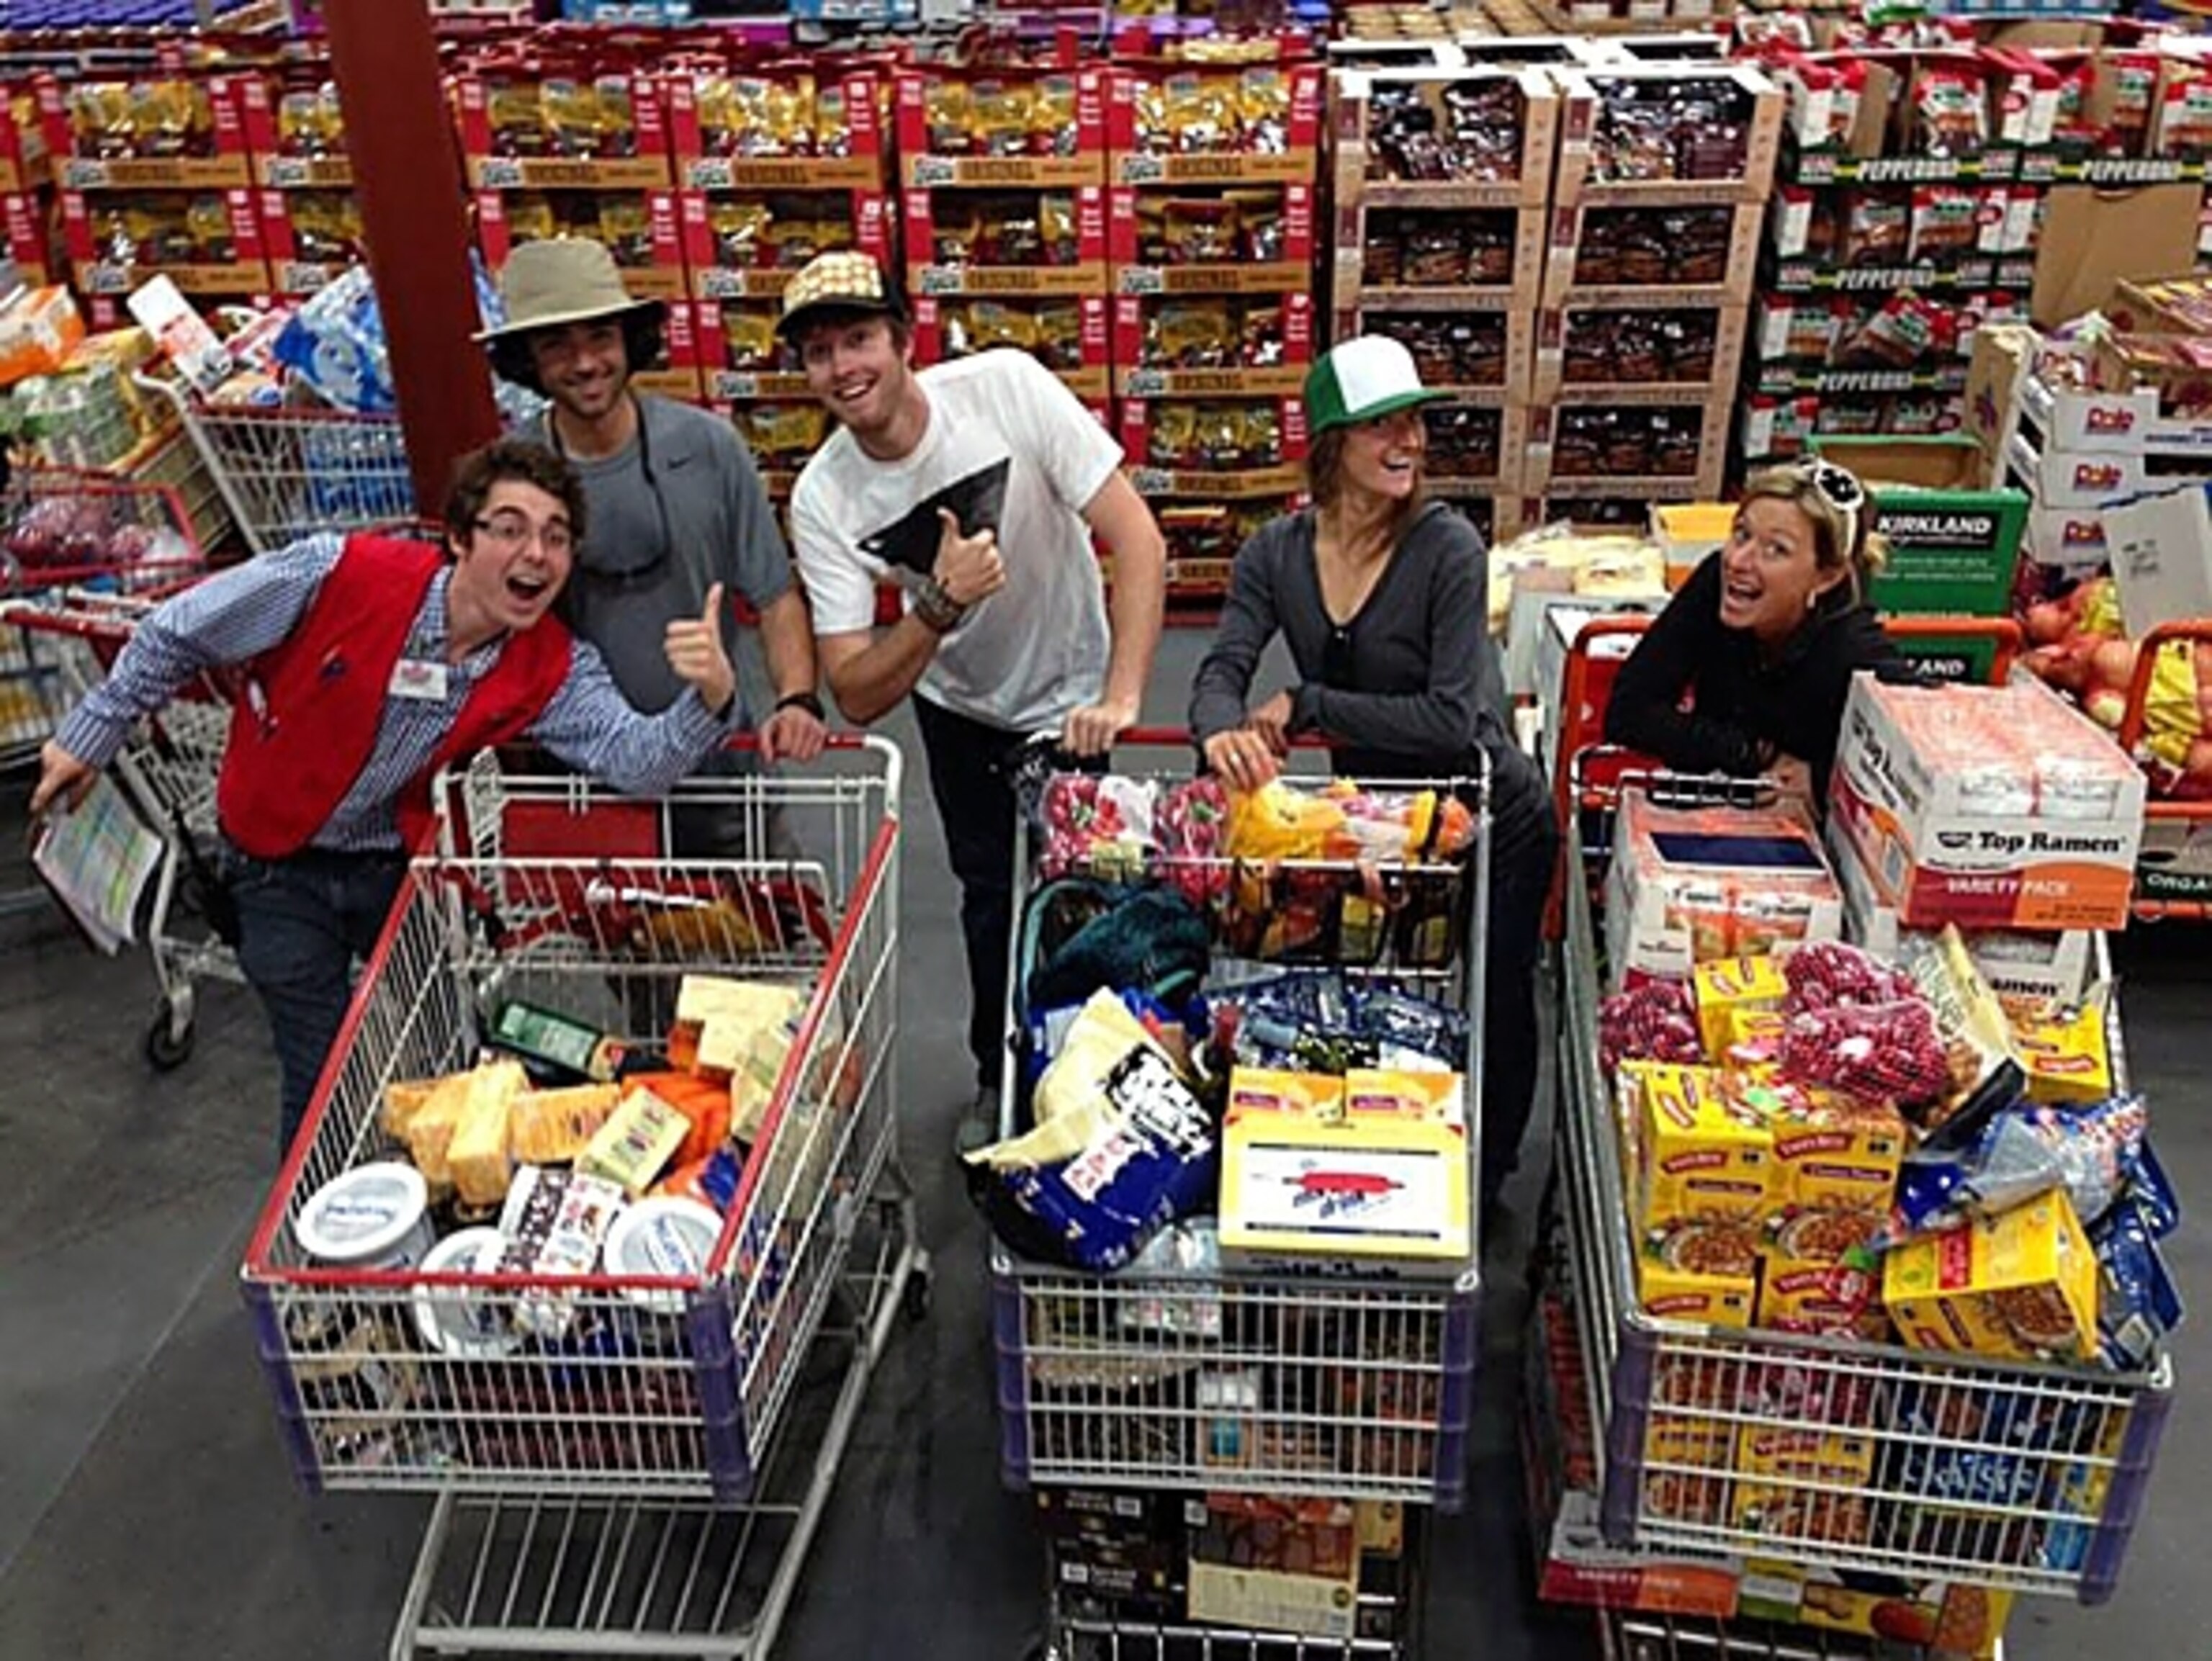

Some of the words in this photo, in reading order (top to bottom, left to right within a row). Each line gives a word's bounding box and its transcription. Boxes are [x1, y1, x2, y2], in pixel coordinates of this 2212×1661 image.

[1856, 159, 1960, 181] PEPPERONI
[2079, 159, 2180, 181] PEPPERONI
[1836, 268, 1936, 289] PEPPERONI
[2086, 406, 2135, 433] Dole
[2074, 463, 2122, 491] Dole
[1877, 514, 1993, 536] KIRKLAND
[1979, 831, 2025, 853] Top
[2028, 832, 2121, 853] Ramen
[1947, 878, 2018, 893] VARIETY
[2020, 880, 2069, 896] PACK
